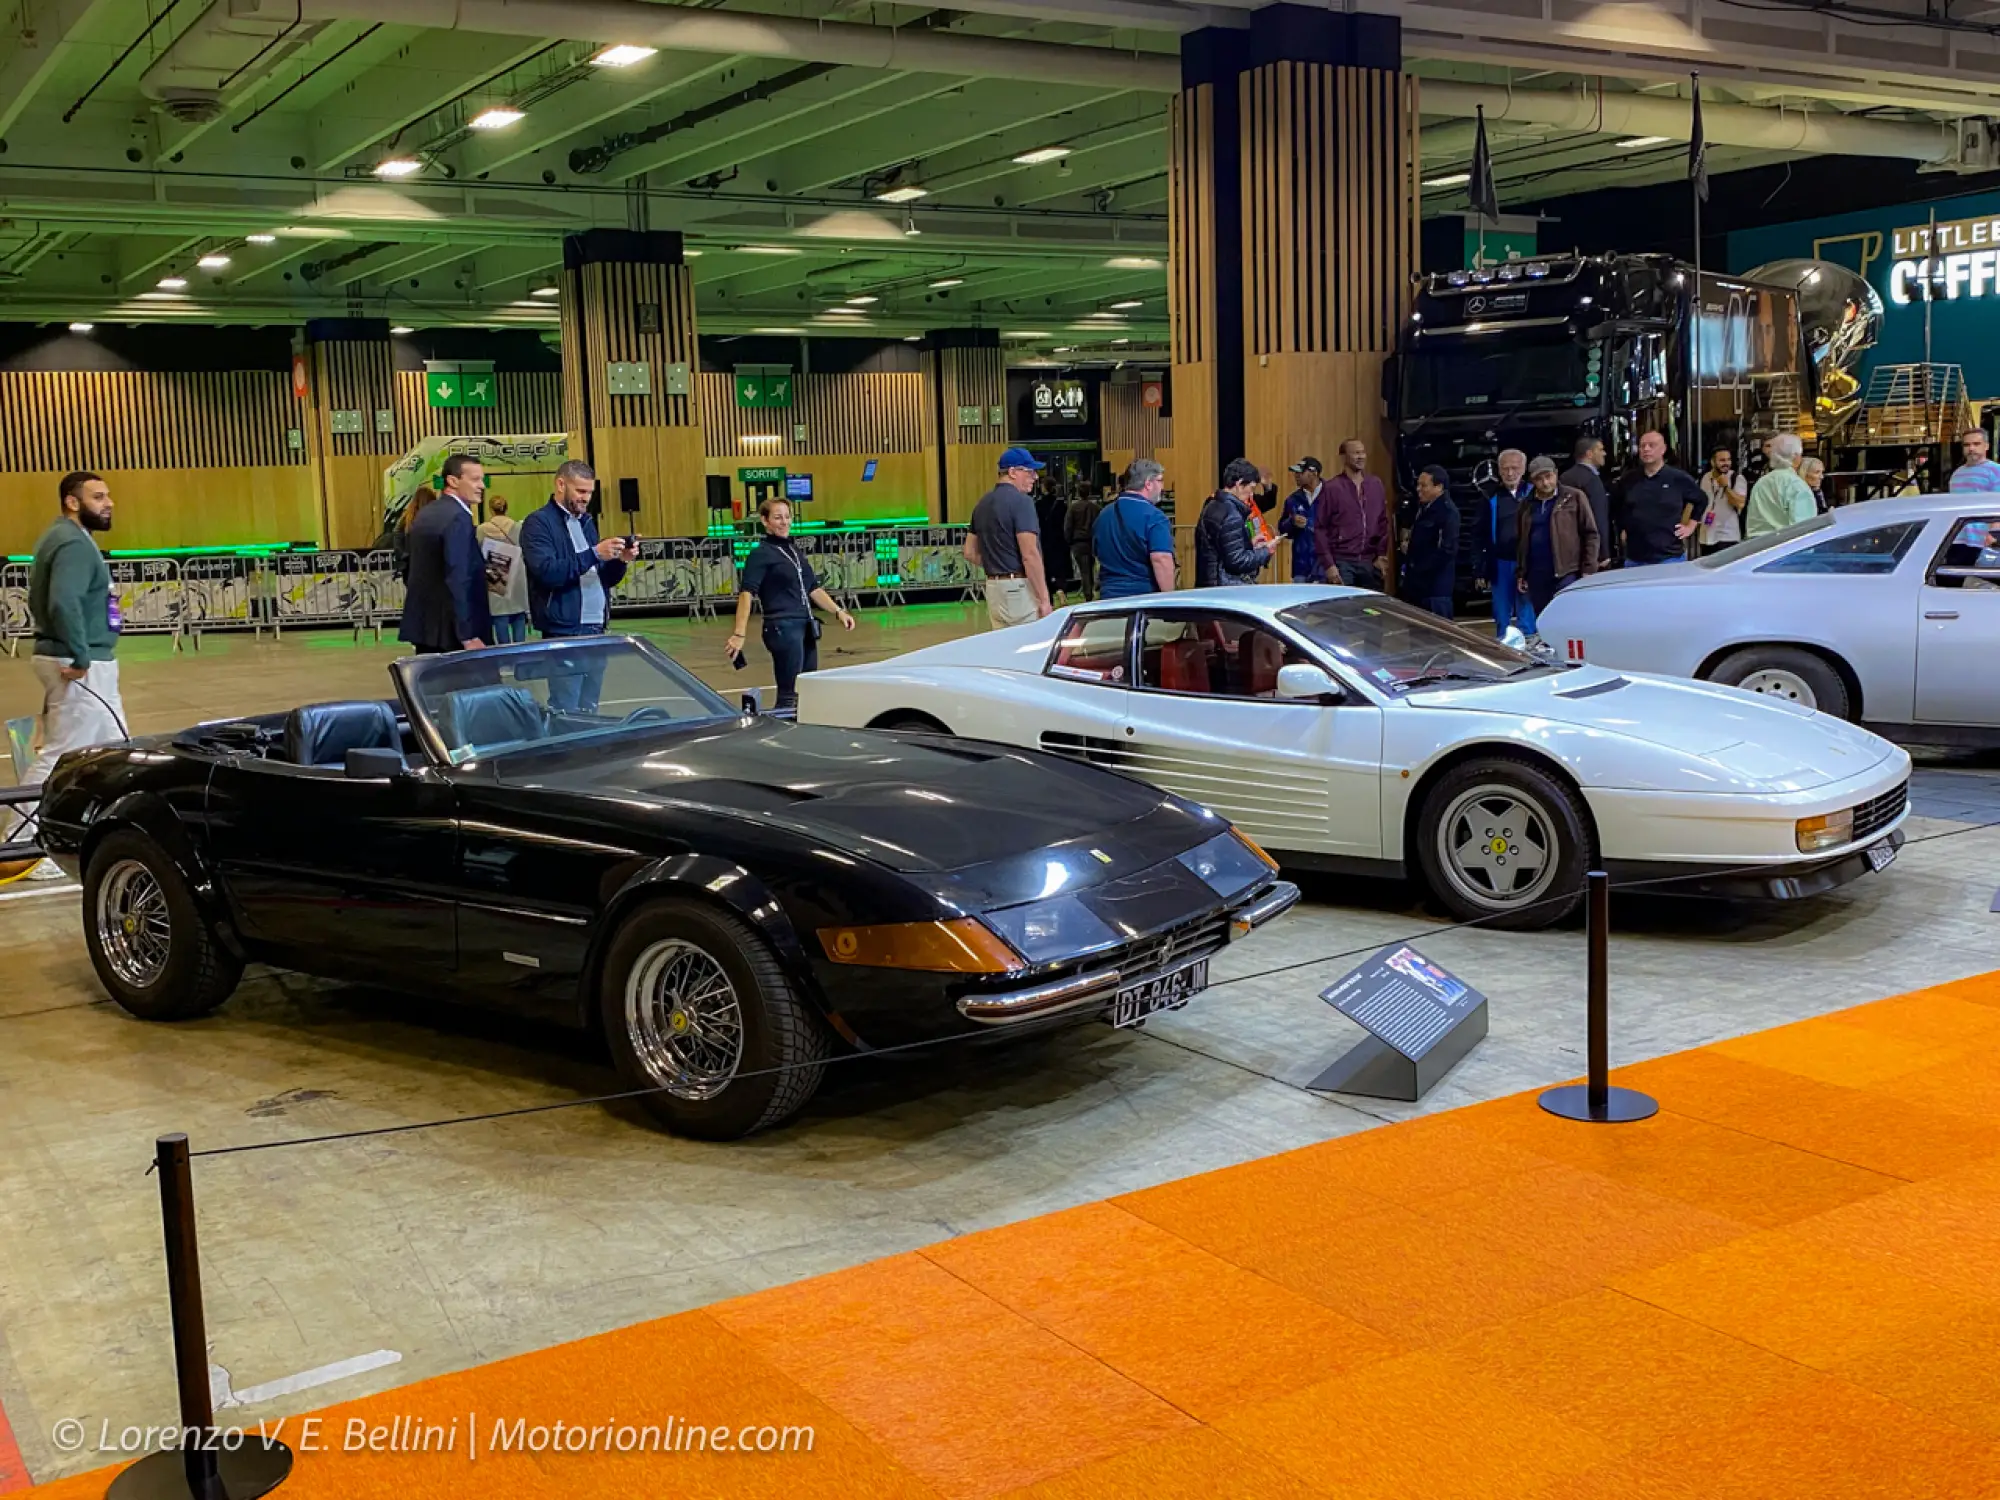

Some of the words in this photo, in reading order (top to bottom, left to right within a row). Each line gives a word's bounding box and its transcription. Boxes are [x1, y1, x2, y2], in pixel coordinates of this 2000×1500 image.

[1890, 249, 2000, 304] CFF
[448, 443, 565, 457] PEUGEOT
[744, 468, 779, 479] SORTIE
